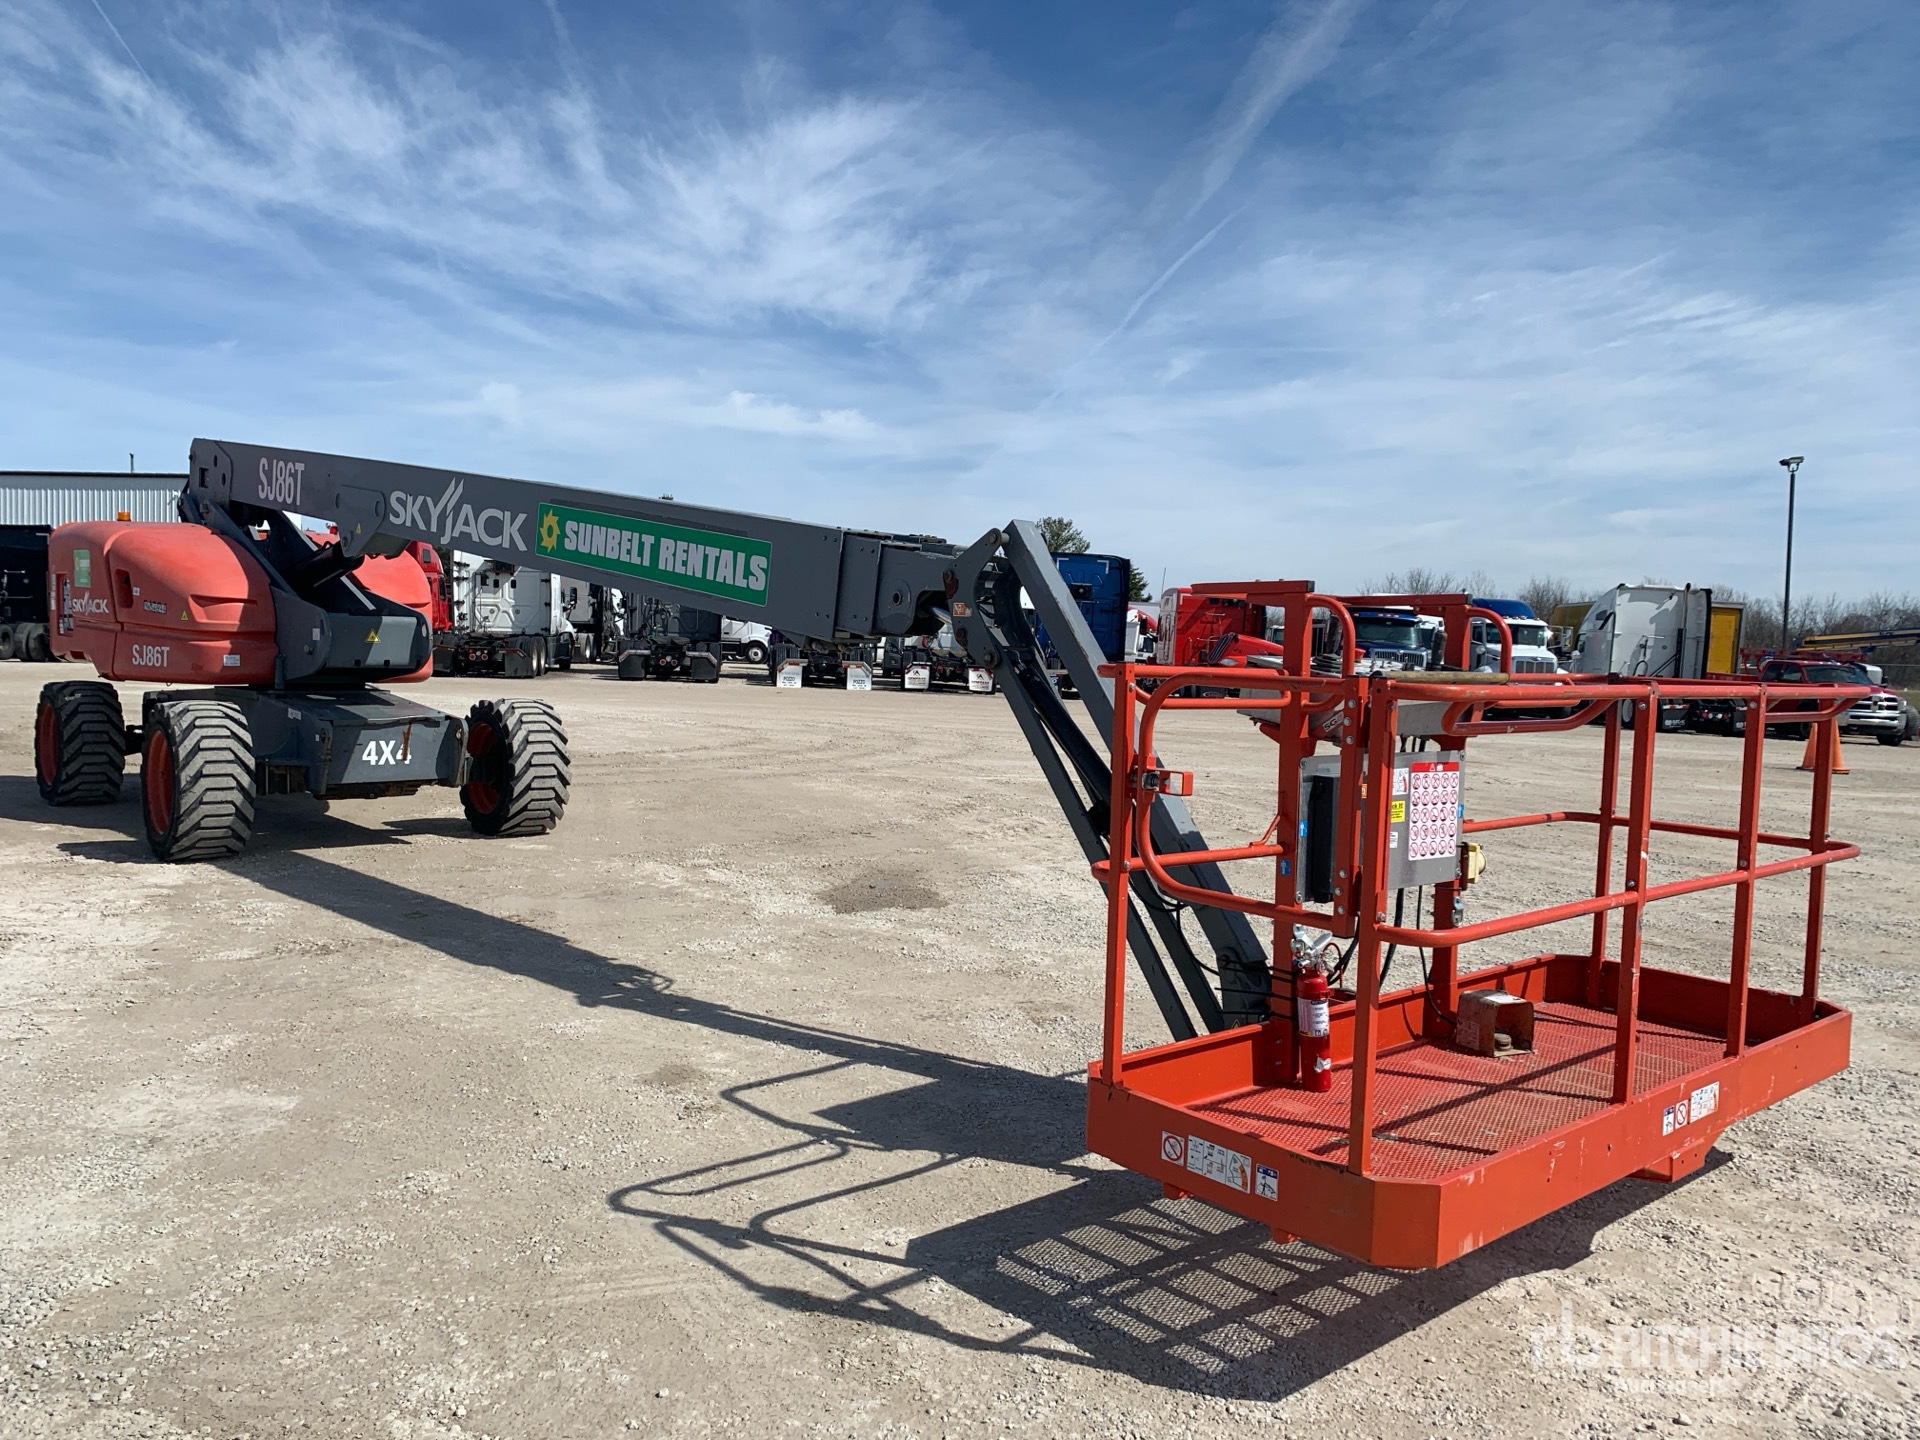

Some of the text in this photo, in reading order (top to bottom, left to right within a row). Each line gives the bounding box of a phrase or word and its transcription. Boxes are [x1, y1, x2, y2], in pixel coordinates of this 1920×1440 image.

[258, 457, 305, 506] SJ86T
[389, 477, 529, 551] SKYJACK
[564, 520, 768, 591] SUNBELT RENTALS
[72, 591, 109, 615] SKYJACK
[132, 644, 170, 668] SJ86T
[361, 740, 411, 766] 4X4
